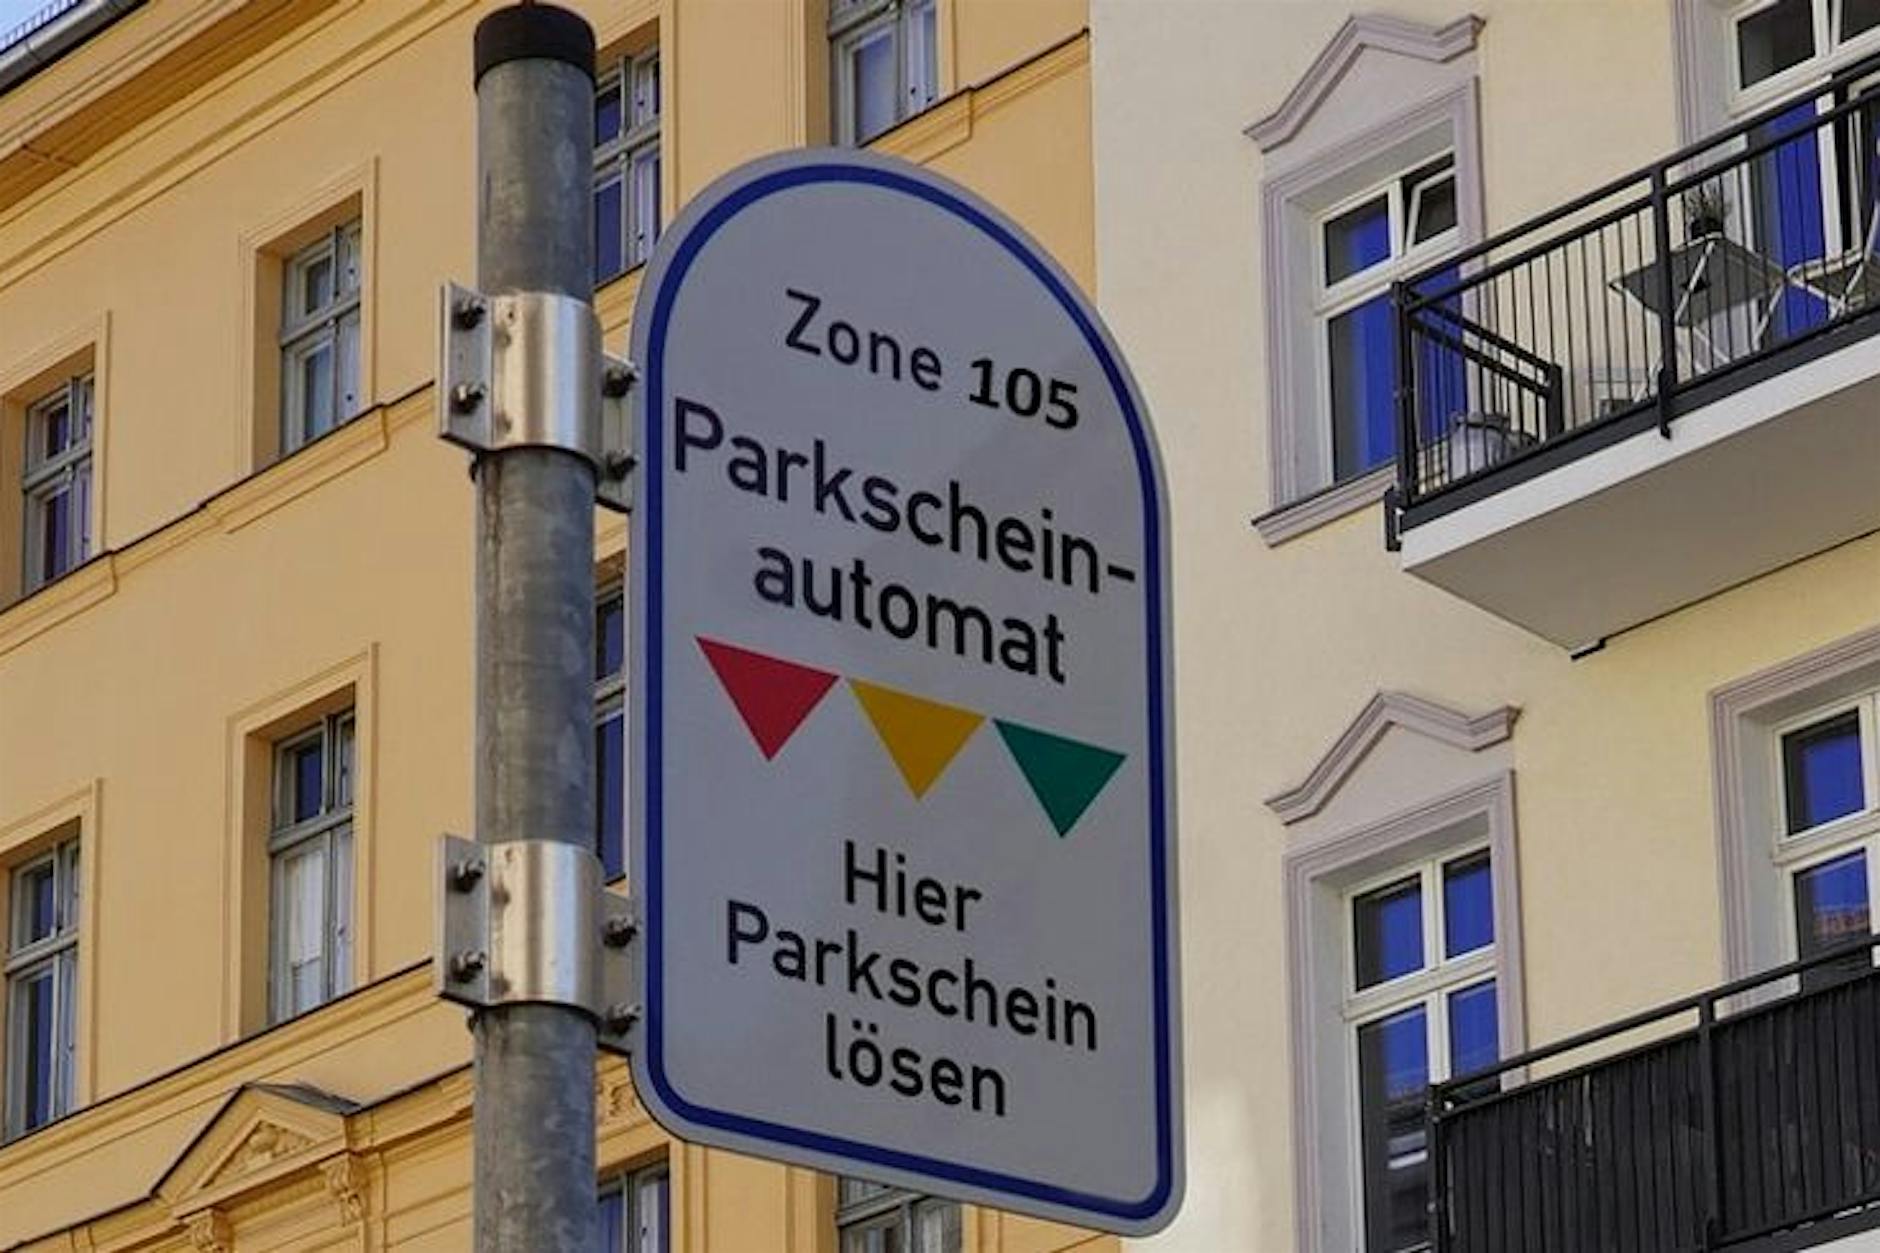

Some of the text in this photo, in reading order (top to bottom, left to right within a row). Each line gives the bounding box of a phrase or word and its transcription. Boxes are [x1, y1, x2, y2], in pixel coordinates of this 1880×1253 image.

[784, 287, 1081, 431] Zone 105
[674, 397, 1136, 595] Parkschein-
[753, 545, 1066, 686] automat
[844, 839, 983, 933] Hier
[727, 899, 1098, 1052] Parkschein
[826, 1012, 1006, 1118] lösen
